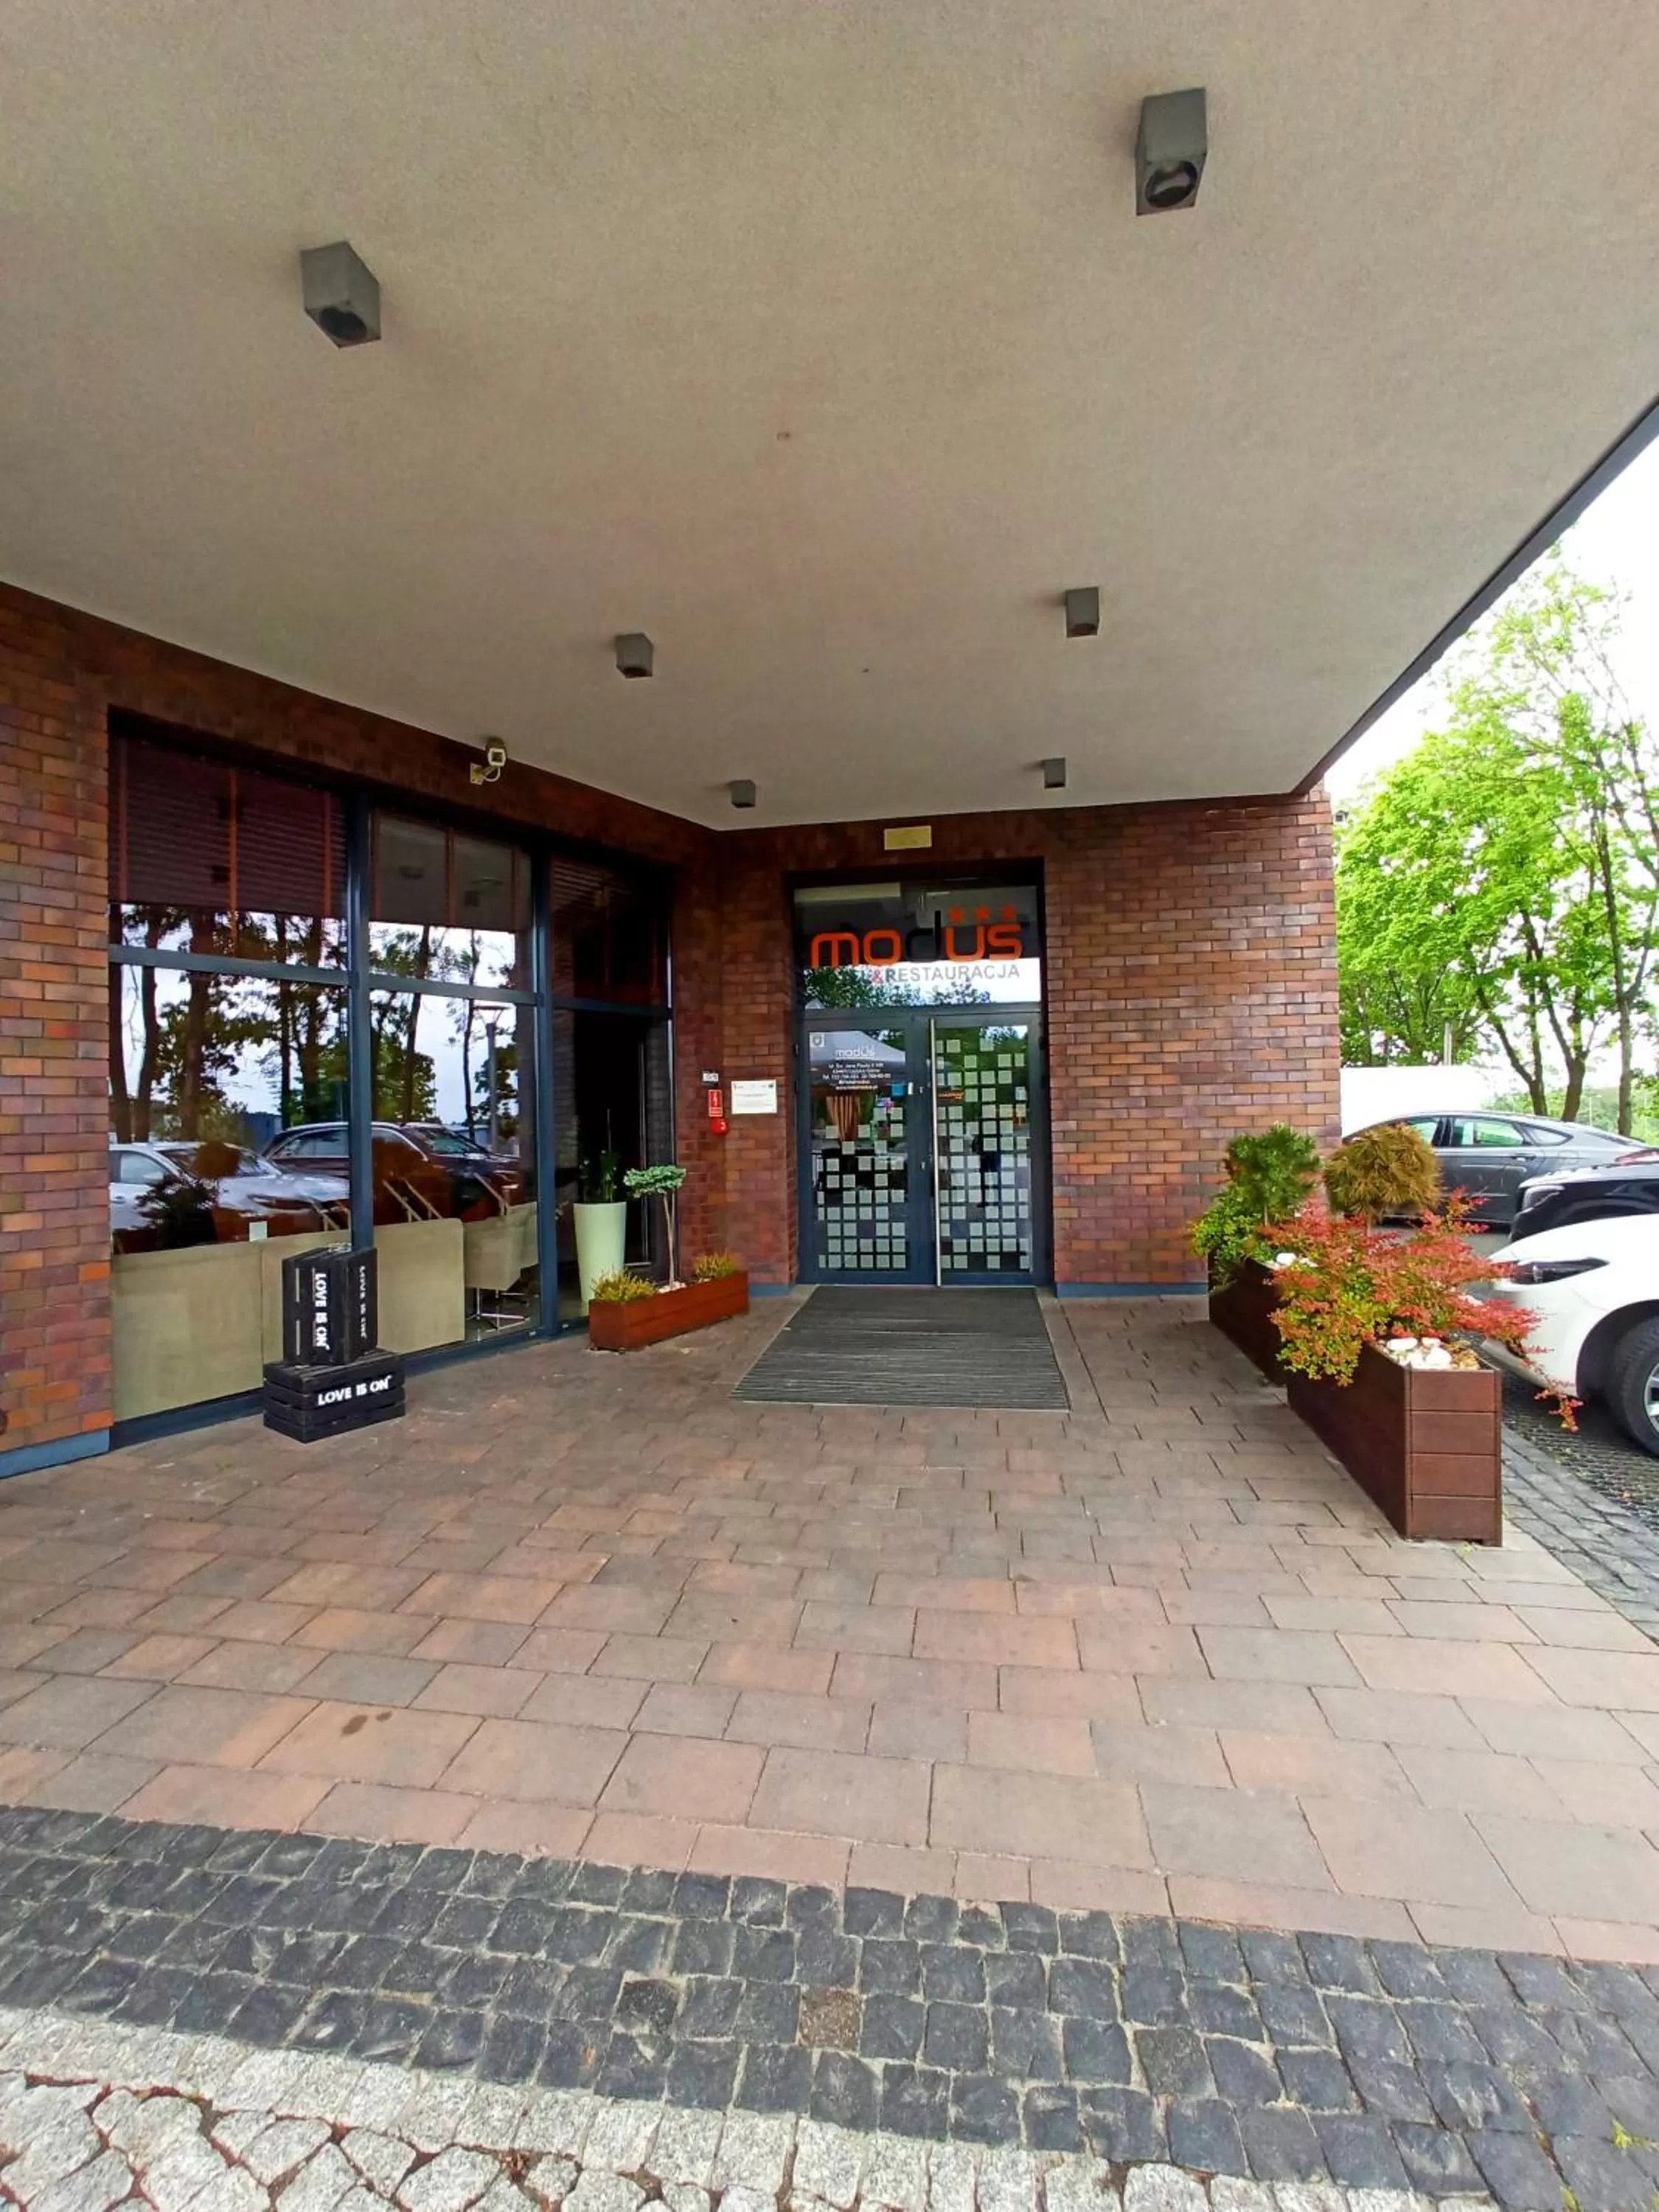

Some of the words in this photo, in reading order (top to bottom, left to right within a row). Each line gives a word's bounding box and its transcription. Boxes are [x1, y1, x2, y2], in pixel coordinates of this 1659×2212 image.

[885, 964, 1020, 983] RESTAURACJA
[315, 1273, 327, 1307] LOVE
[315, 1312, 328, 1324] IS
[318, 1387, 352, 1406] LOVE
[355, 1382, 368, 1397] IS
